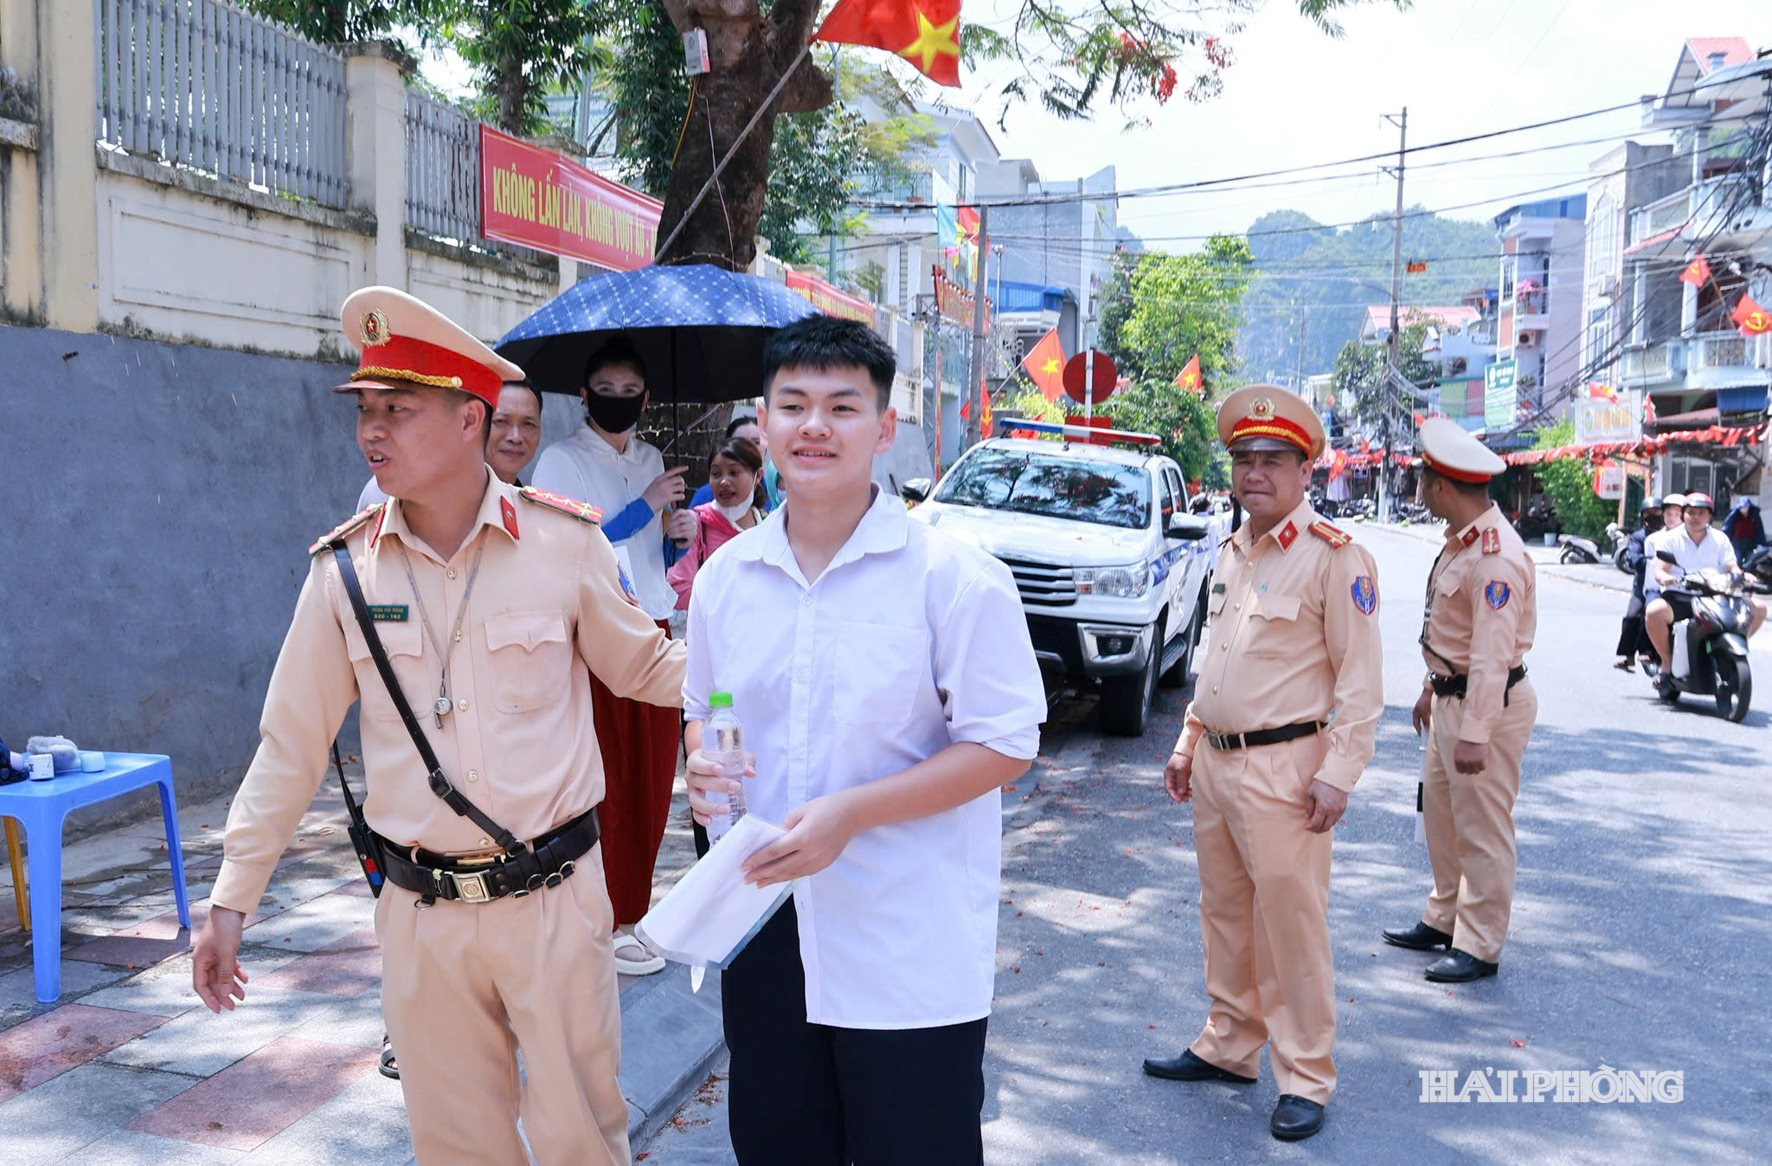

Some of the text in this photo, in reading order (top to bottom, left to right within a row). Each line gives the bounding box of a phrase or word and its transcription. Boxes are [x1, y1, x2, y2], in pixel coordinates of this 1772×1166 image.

[493, 162, 535, 222] KHÔNG
[539, 168, 560, 229] LẤN
[585, 194, 613, 248] KHÔNG
